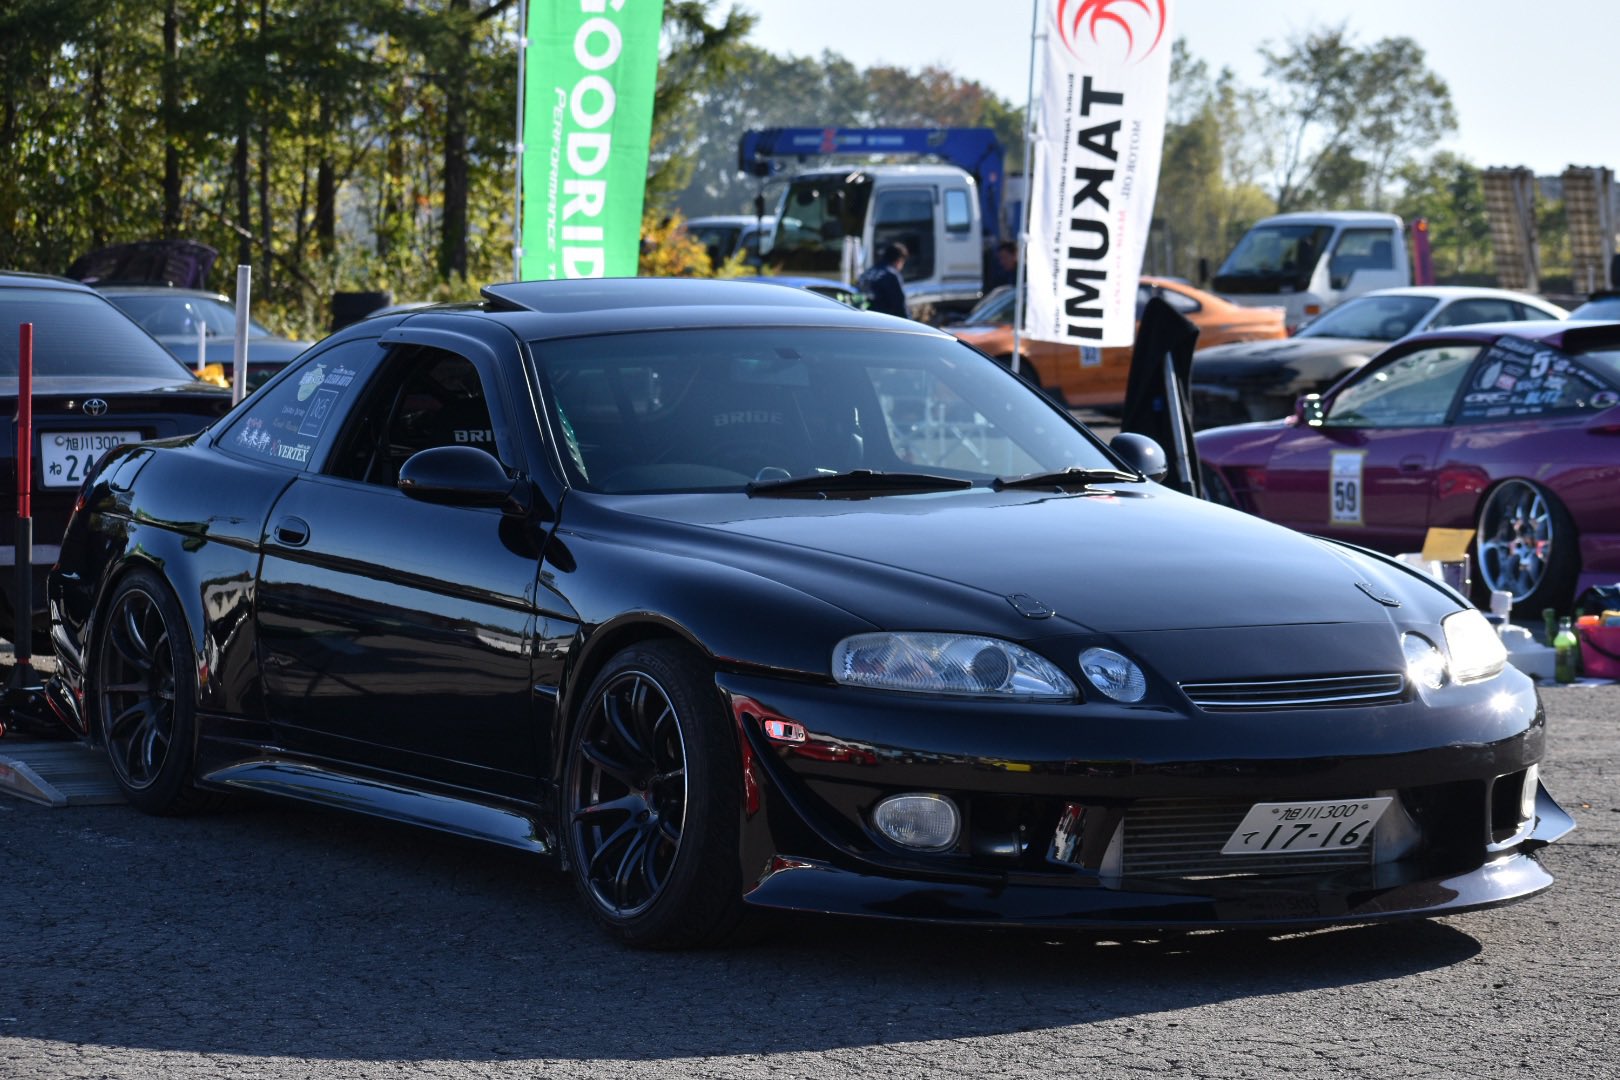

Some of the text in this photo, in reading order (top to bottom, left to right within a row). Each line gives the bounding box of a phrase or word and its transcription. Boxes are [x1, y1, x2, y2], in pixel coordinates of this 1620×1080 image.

[561, 0, 625, 280] OODRID
[713, 410, 784, 427] BRIDE
[453, 429, 493, 442] BRI
[278, 444, 310, 462] VERTEX
[49, 462, 62, 475] ね
[1335, 481, 1356, 512] 59
[1278, 804, 1359, 821] 旭川300
[1242, 820, 1370, 850] て 17-16
